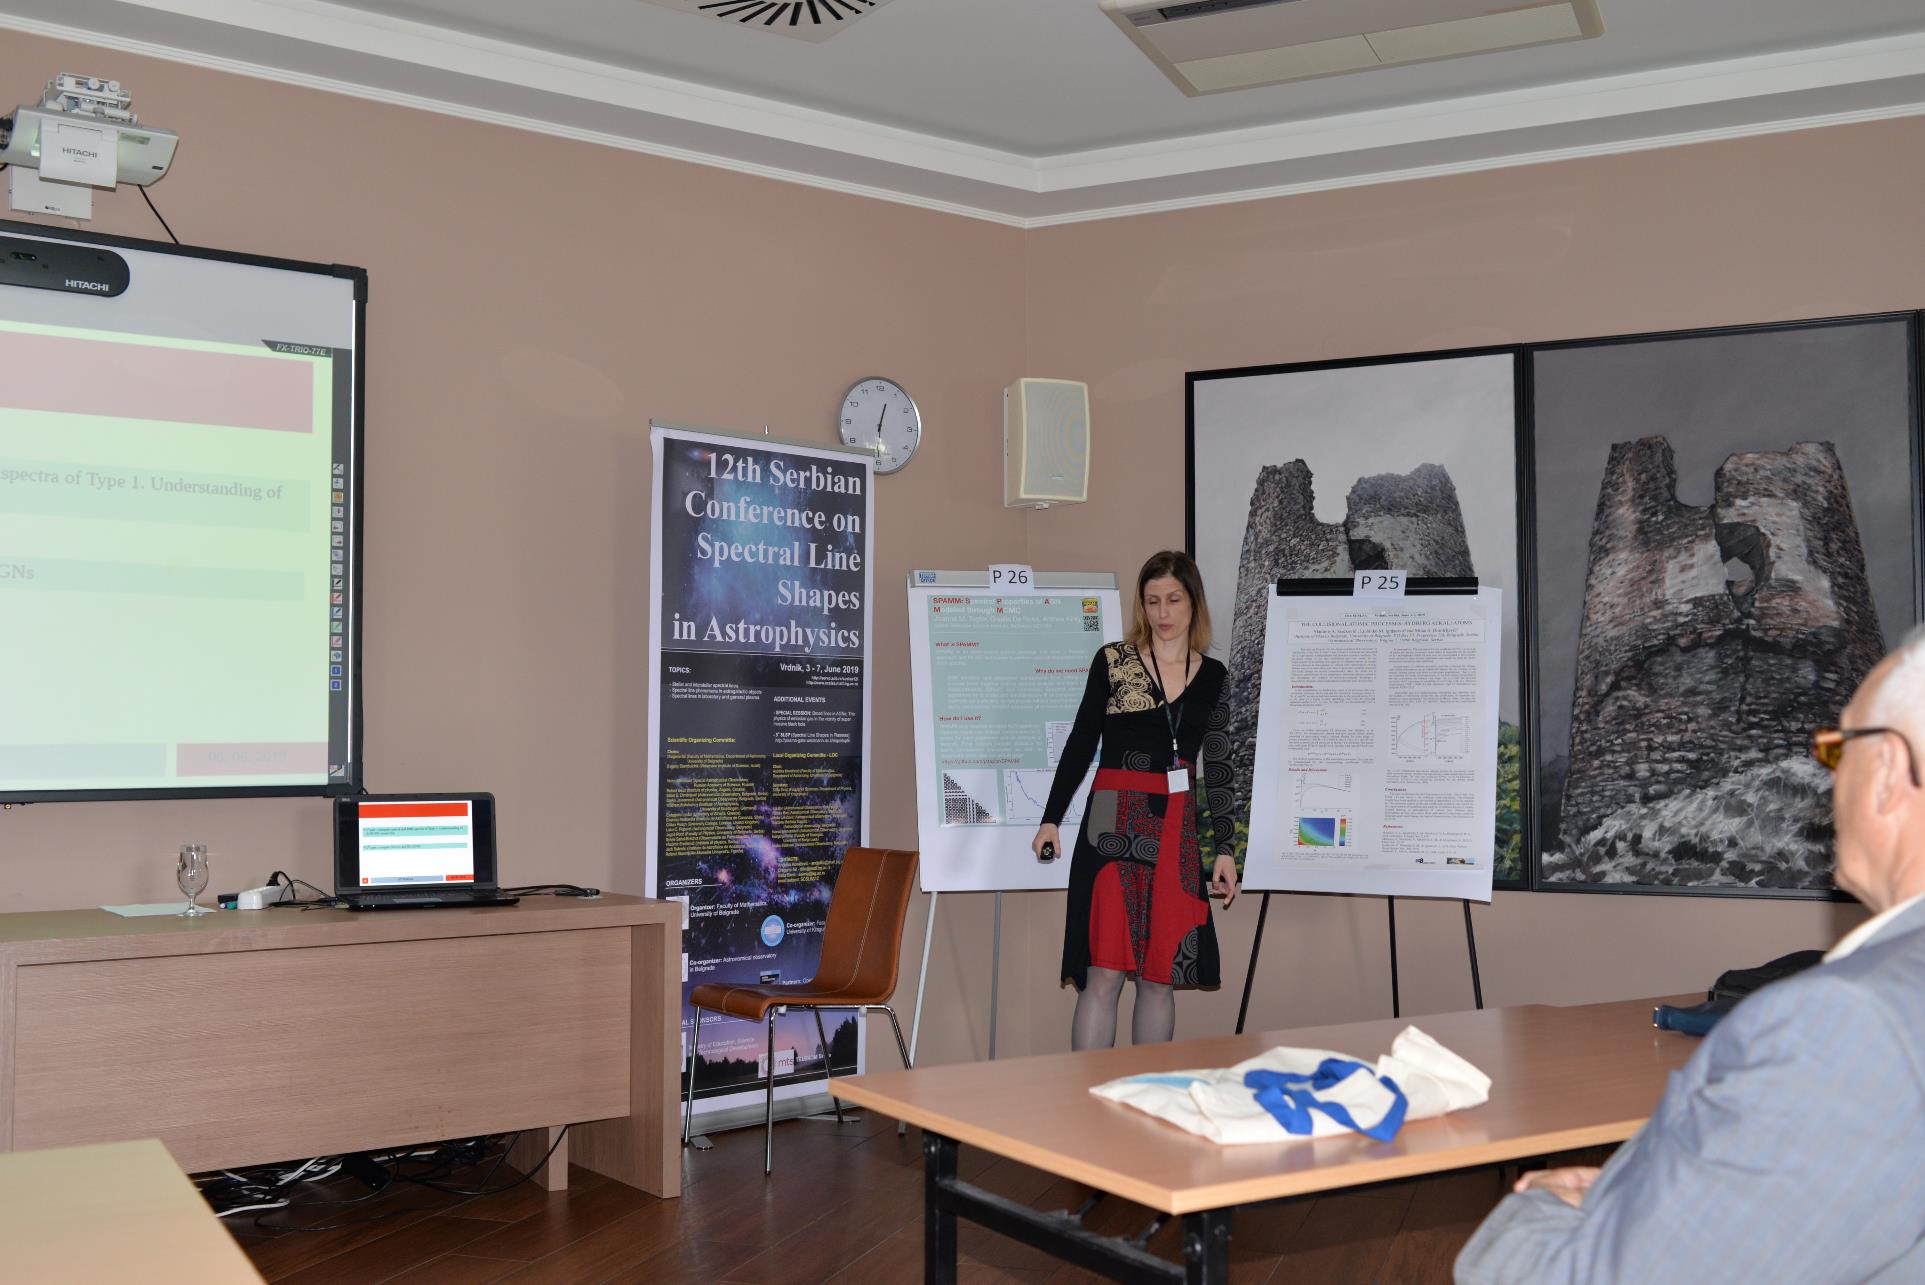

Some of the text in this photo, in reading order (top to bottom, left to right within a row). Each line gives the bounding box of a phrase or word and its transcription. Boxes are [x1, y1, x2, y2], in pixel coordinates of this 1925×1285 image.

[62, 147, 98, 159] HITACHI
[65, 279, 110, 292] HITACHI
[276, 343, 327, 356] FX-TRIO-77E
[707, 452, 862, 495] 12th Serbian
[1, 468, 59, 485] spectra
[64, 470, 83, 485] of
[87, 472, 126, 490] Type
[151, 476, 262, 500] Understanding
[266, 484, 284, 499] of
[685, 490, 861, 534] Conference on
[697, 532, 861, 572] Spectral Line
[992, 570, 1028, 584] P 26
[1361, 575, 1399, 590] P 25
[777, 579, 860, 615] Shapes
[672, 612, 860, 653] in Astrophysics
[668, 666, 692, 674] TOPICS:
[780, 663, 804, 672] Vrdnik,
[805, 664, 811, 672] 3
[816, 664, 823, 674] 7,
[824, 665, 841, 673] June
[842, 665, 859, 674] 2019
[665, 878, 703, 887] ORGANIZERS
[778, 1058, 794, 1068] mts
